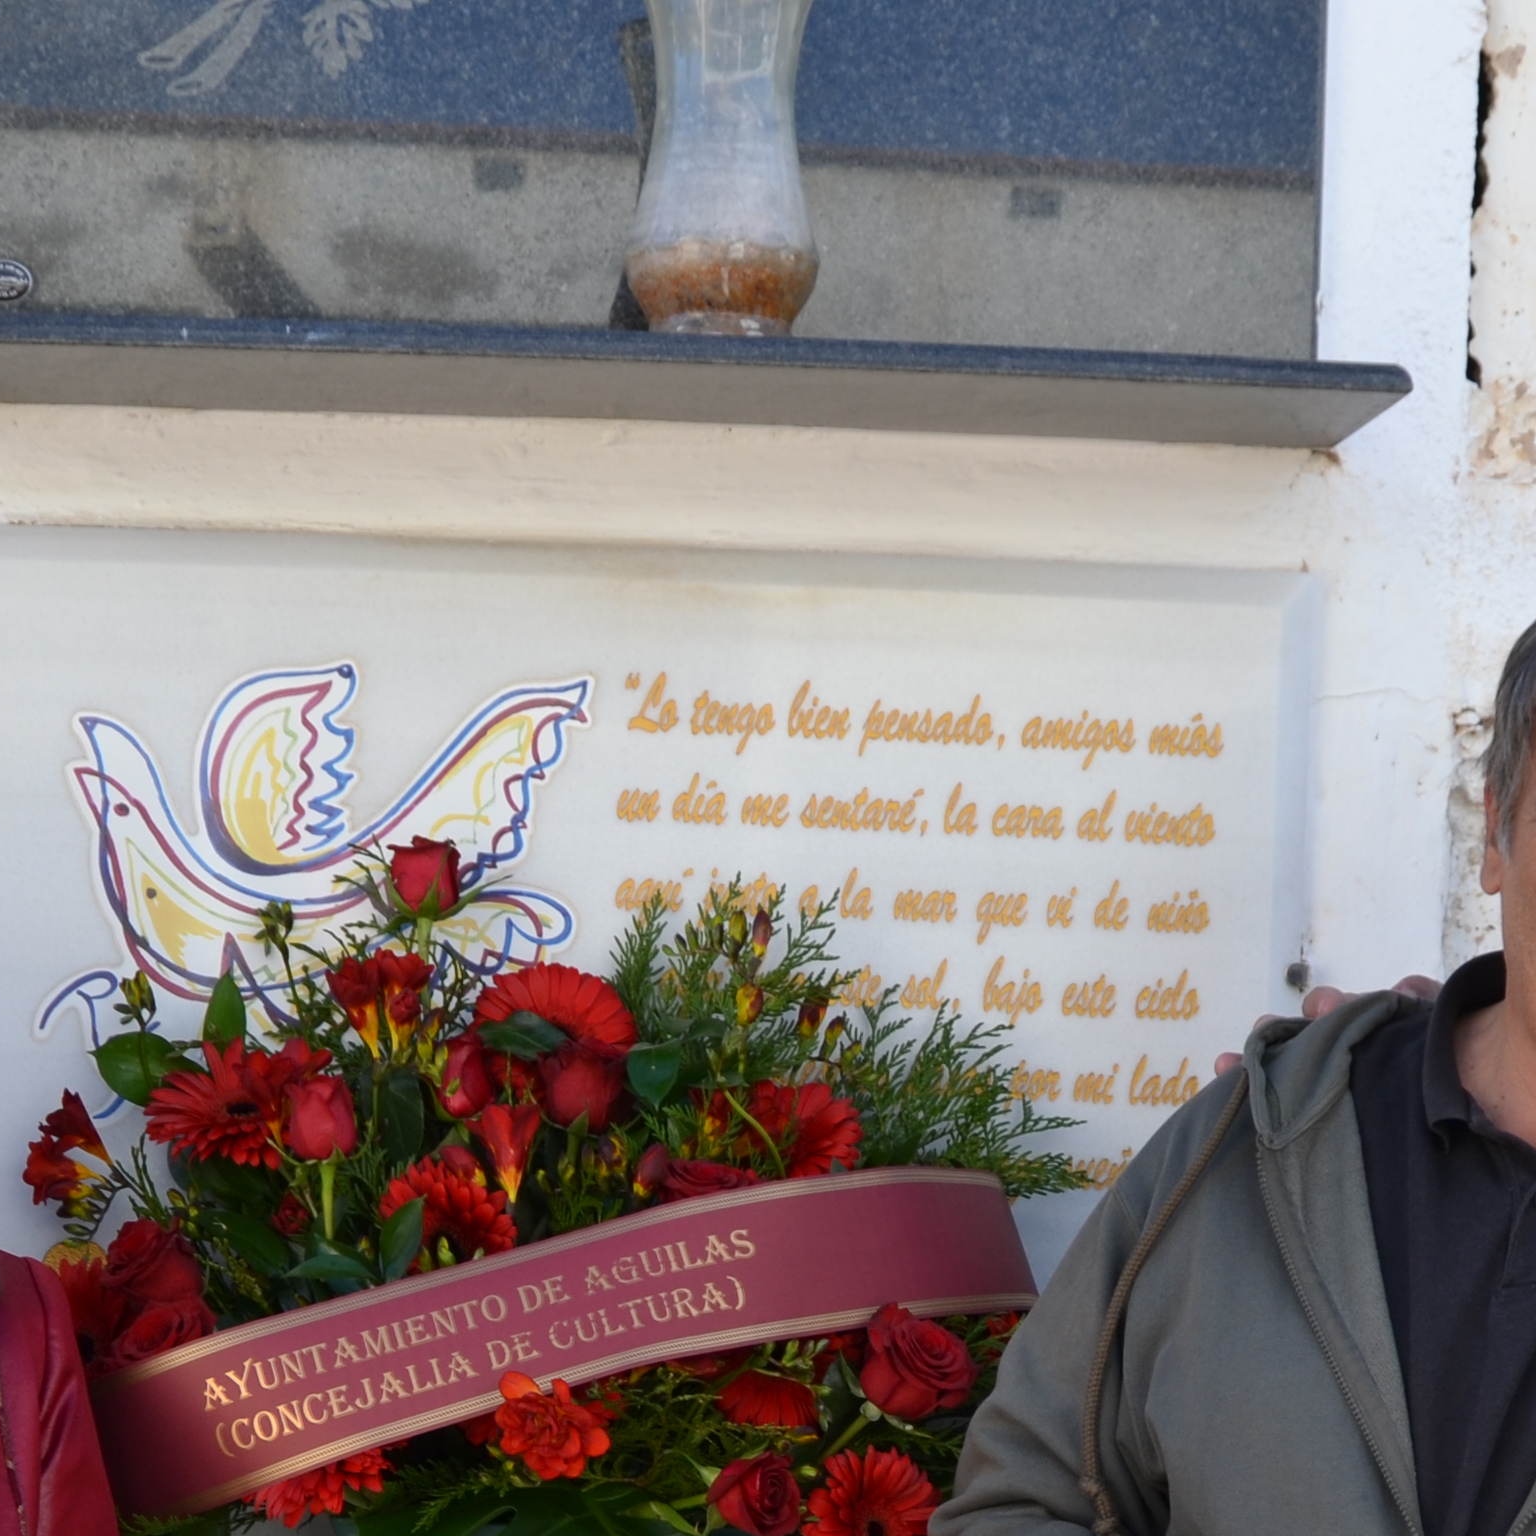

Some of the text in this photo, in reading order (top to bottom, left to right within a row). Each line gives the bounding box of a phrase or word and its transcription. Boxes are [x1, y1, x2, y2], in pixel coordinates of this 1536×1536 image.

[690, 689, 776, 756] tengo
[787, 679, 851, 740] bien
[1021, 710, 1135, 771] amigos
[1148, 712, 1223, 759] míos
[616, 788, 661, 823] un
[672, 772, 727, 826] día
[740, 793, 790, 828] me
[943, 782, 978, 837] la
[991, 803, 1064, 841] cara
[1076, 790, 1118, 842] al
[1124, 802, 1216, 848] viento
[614, 867, 694, 927] aquí
[798, 884, 824, 919] a
[840, 867, 874, 921] la
[893, 889, 958, 924] mar
[976, 891, 1029, 946] que
[1047, 886, 1078, 929] vi
[1094, 880, 1130, 932] de
[1147, 889, 1211, 935] niño
[898, 958, 961, 1012] sol,
[982, 955, 1044, 1028] bajo
[1061, 974, 1118, 1019] este
[1135, 969, 1201, 1021] cielo
[1005, 1060, 1062, 1114] por
[1073, 1063, 1121, 1106] mi
[1129, 1054, 1200, 1107] lado
[203, 1229, 758, 1412] AYUNTAMIENTO DE AGUILAS
[215, 1275, 747, 1458] (CONCEJALIA DE CULTURA)
